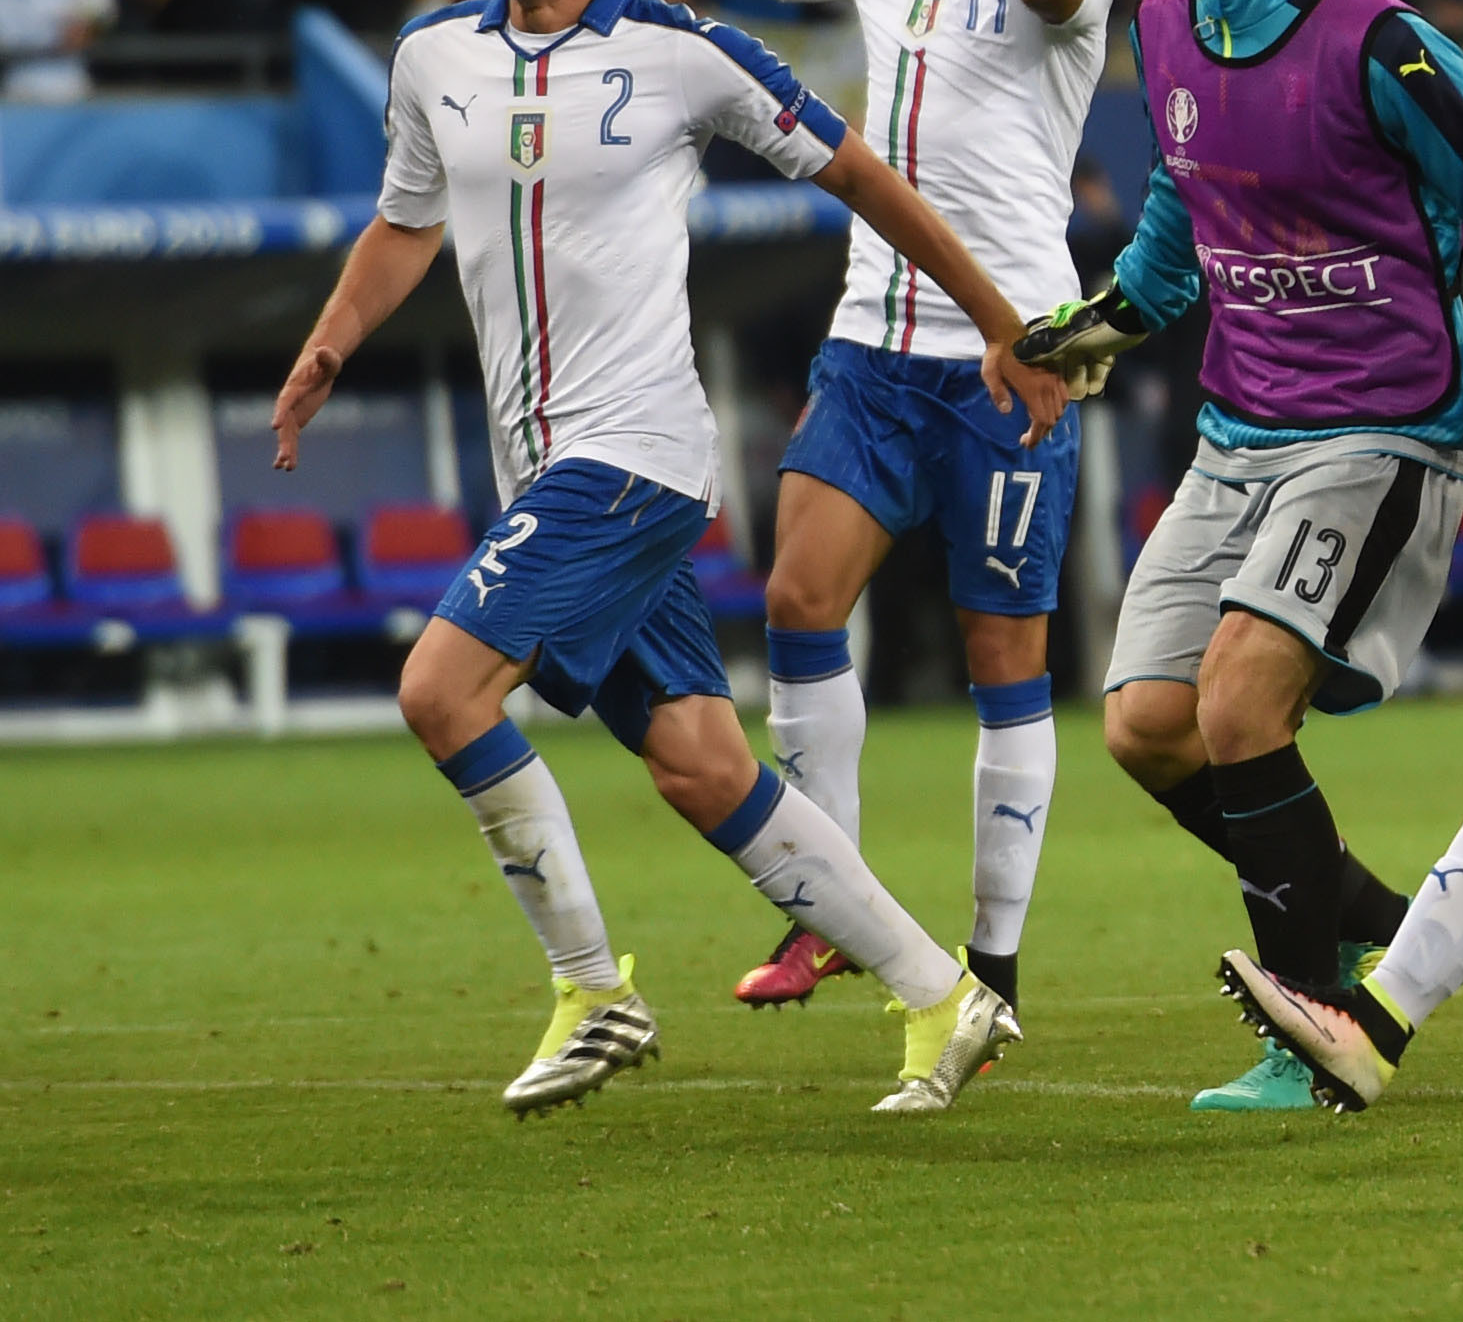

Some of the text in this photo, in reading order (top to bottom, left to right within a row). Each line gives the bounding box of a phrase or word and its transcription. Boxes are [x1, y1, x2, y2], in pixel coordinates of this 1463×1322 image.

[600, 68, 634, 145] 2
[1214, 255, 1380, 304] RESPECT
[480, 512, 538, 575] 2
[986, 470, 1042, 547] 17
[1274, 518, 1347, 605] 13
